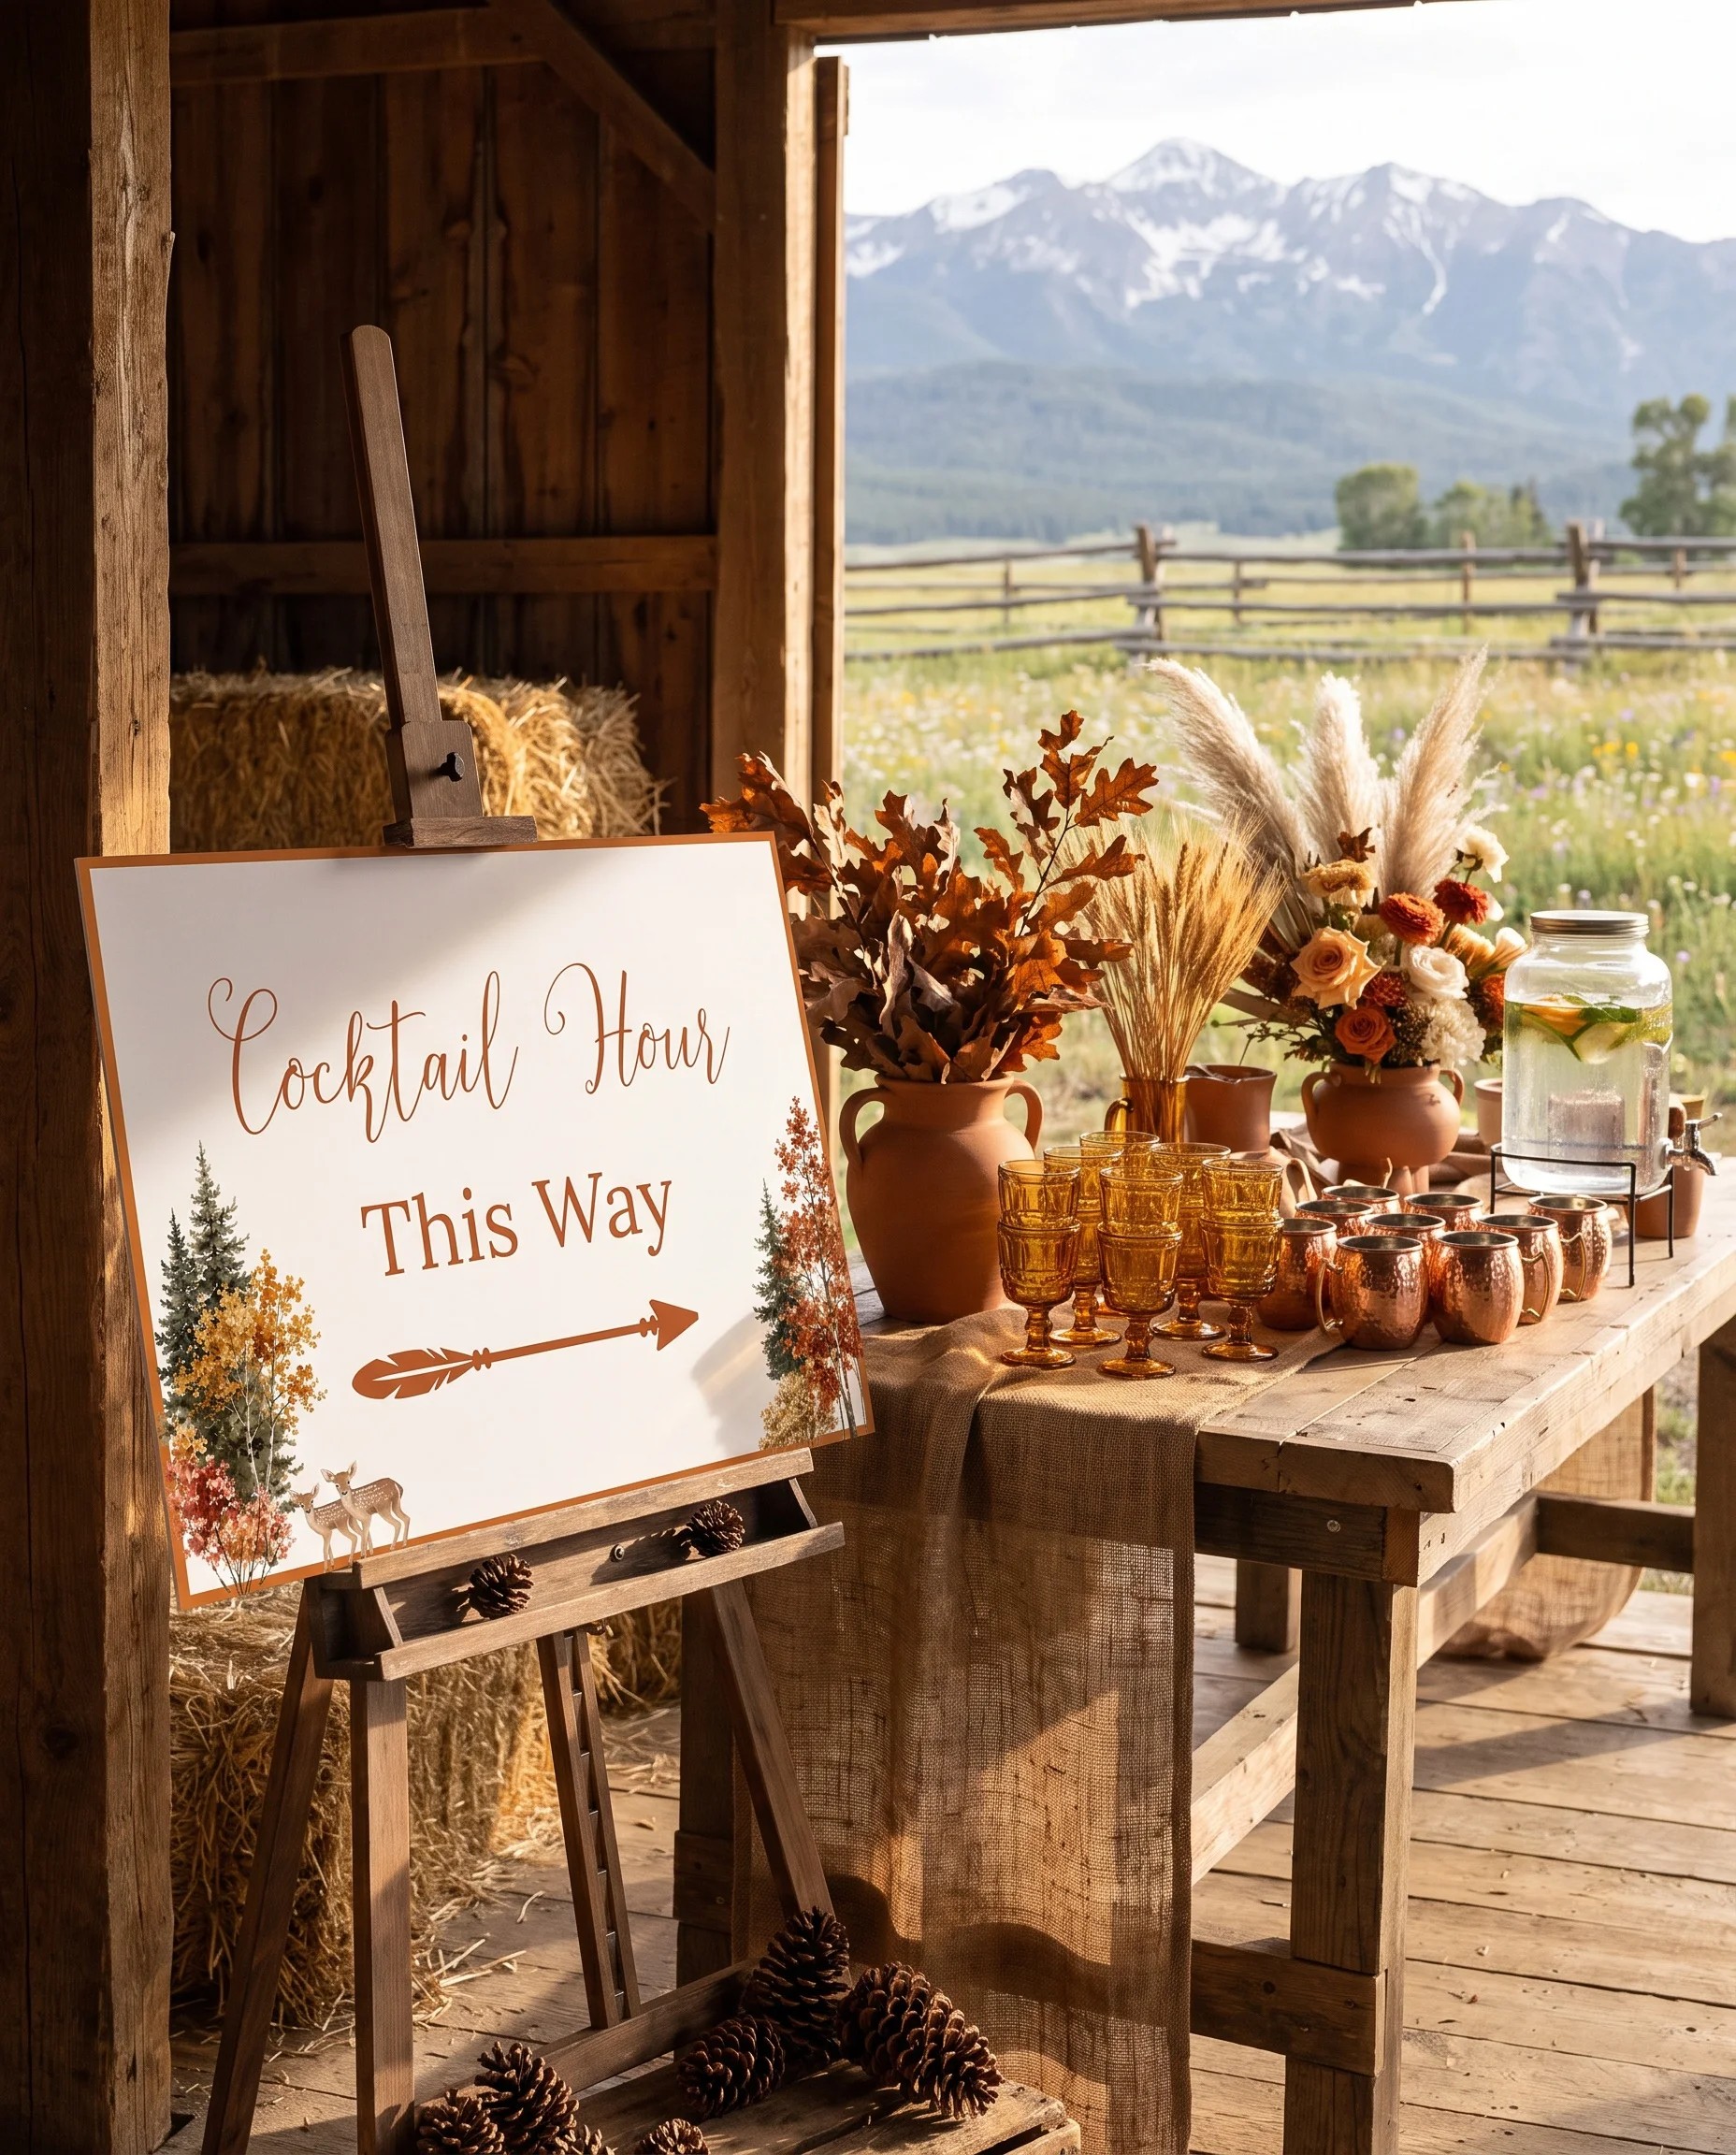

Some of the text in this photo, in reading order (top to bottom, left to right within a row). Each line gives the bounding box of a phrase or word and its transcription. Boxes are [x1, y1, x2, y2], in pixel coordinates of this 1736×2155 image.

[208, 963, 731, 1143] Cocktail Hour
[361, 1172, 672, 1277] This Way
